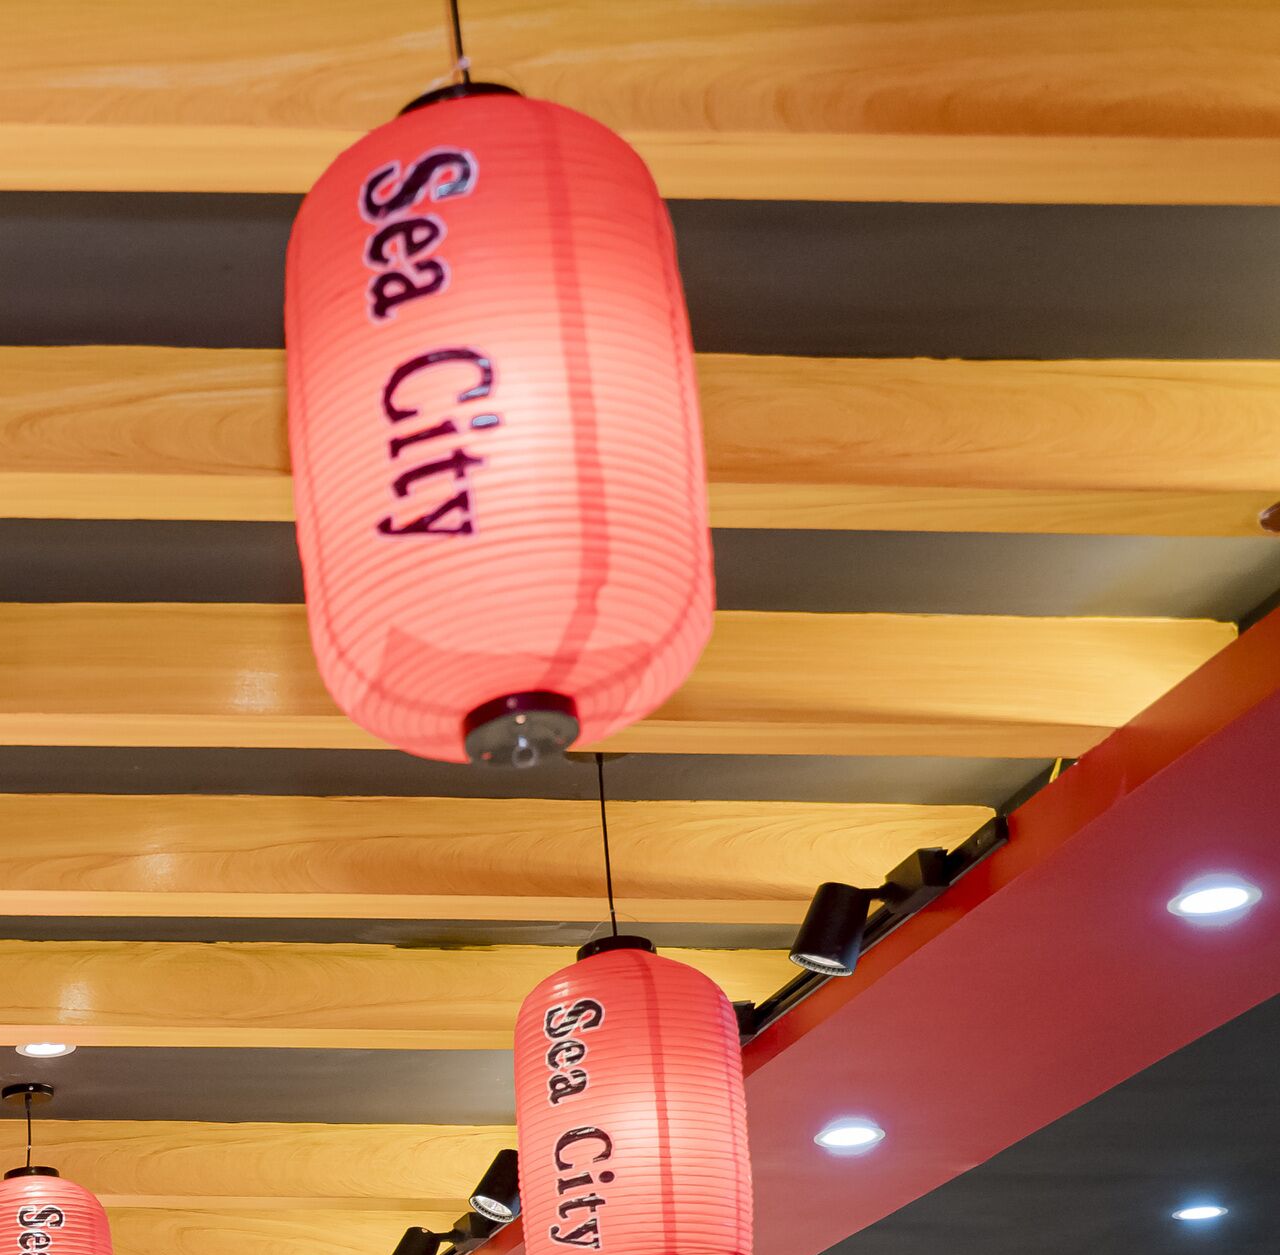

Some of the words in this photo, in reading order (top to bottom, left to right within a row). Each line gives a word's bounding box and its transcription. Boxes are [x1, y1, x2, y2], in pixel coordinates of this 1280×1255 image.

[364, 151, 473, 319] Sea
[377, 348, 500, 537] City
[545, 999, 604, 1105] Sea
[550, 1127, 615, 1249] City
